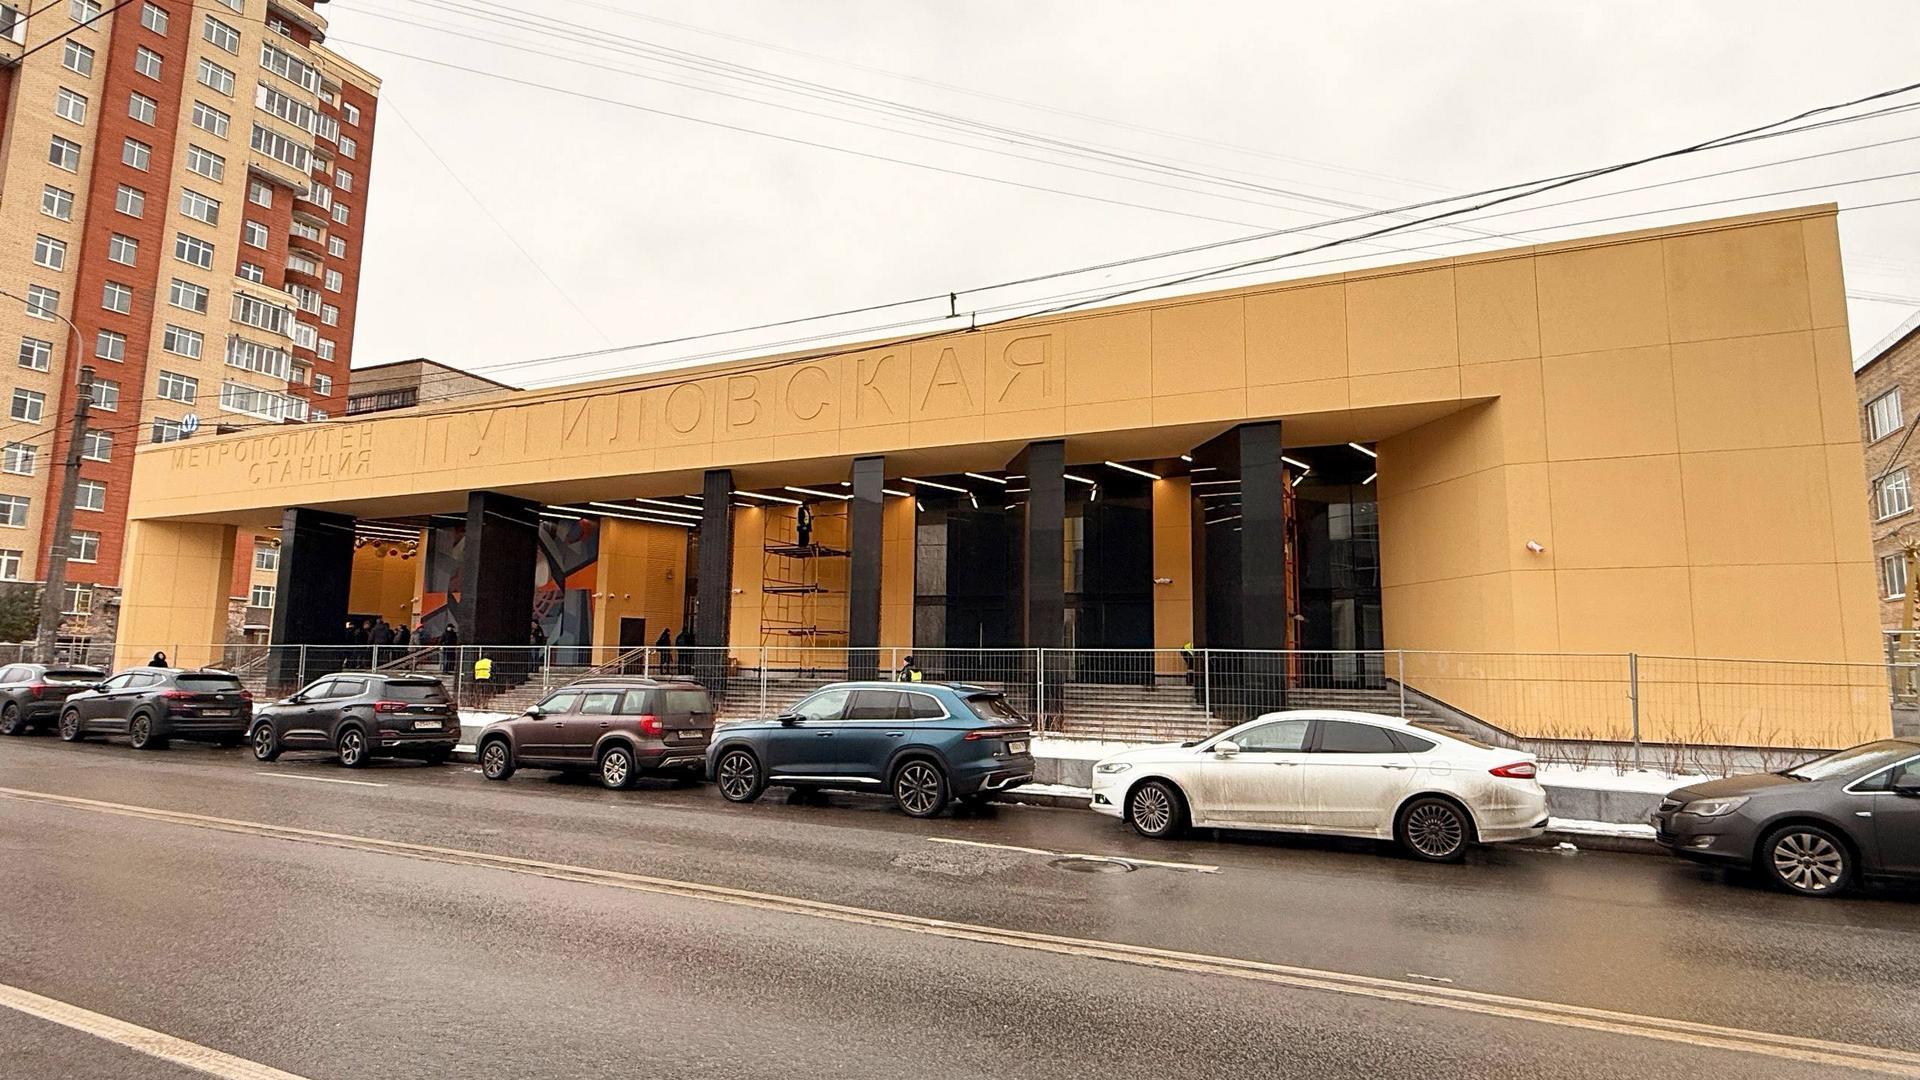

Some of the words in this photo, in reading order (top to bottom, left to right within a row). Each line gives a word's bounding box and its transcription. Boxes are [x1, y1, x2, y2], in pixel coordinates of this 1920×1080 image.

[422, 333, 1053, 466] ПУТИЛОВСКАЯ
[171, 423, 374, 471] МЕТРОПОЛИТЕН
[248, 449, 373, 484] СТАНЦИЯ
